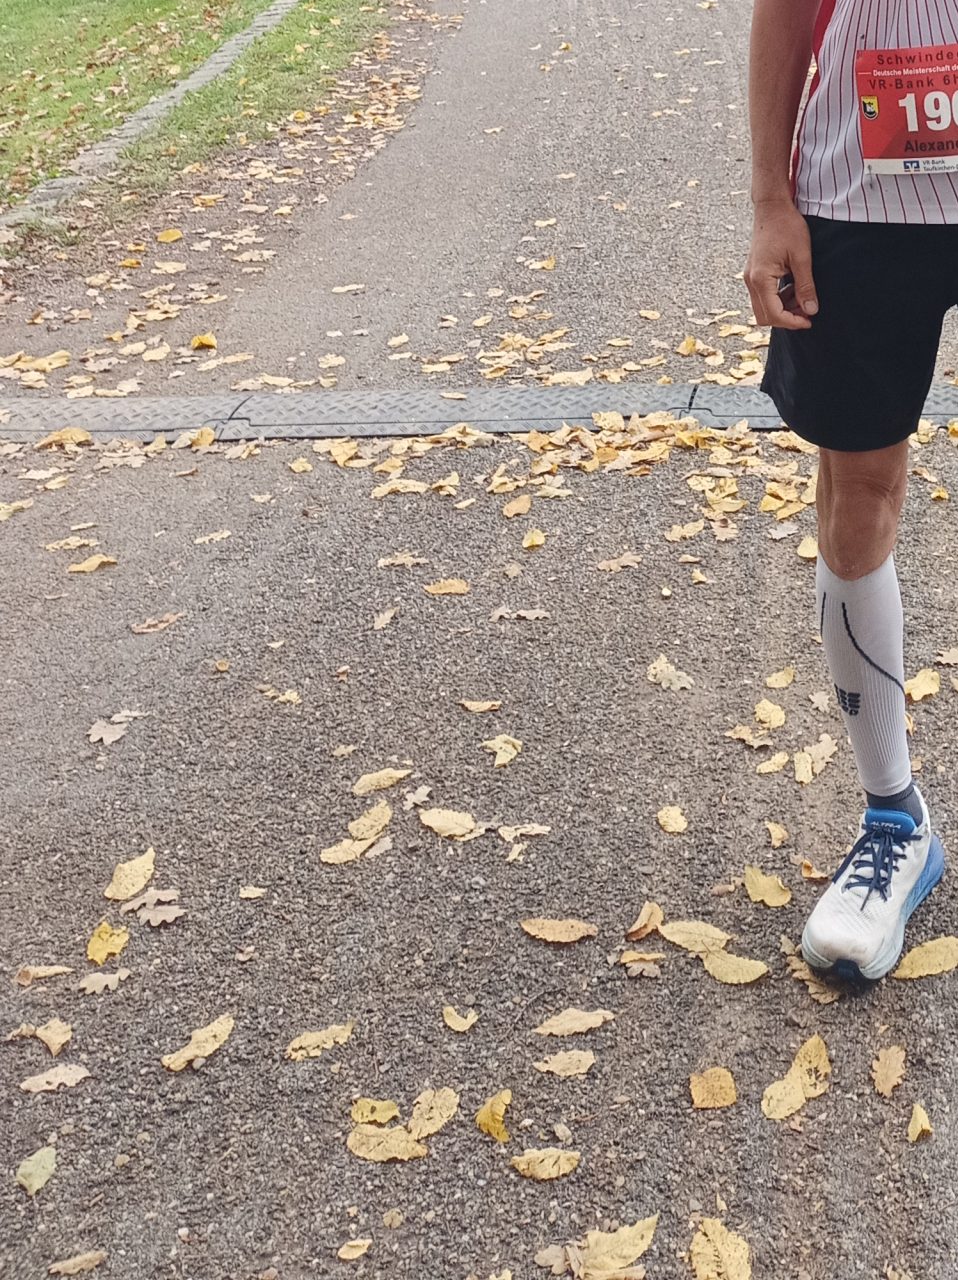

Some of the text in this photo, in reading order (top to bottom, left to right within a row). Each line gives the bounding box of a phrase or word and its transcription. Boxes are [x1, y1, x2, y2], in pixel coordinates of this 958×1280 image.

[873, 69, 902, 77] Deutsche
[902, 64, 951, 76] Meisterschaft
[868, 75, 935, 91] VR-Bank
